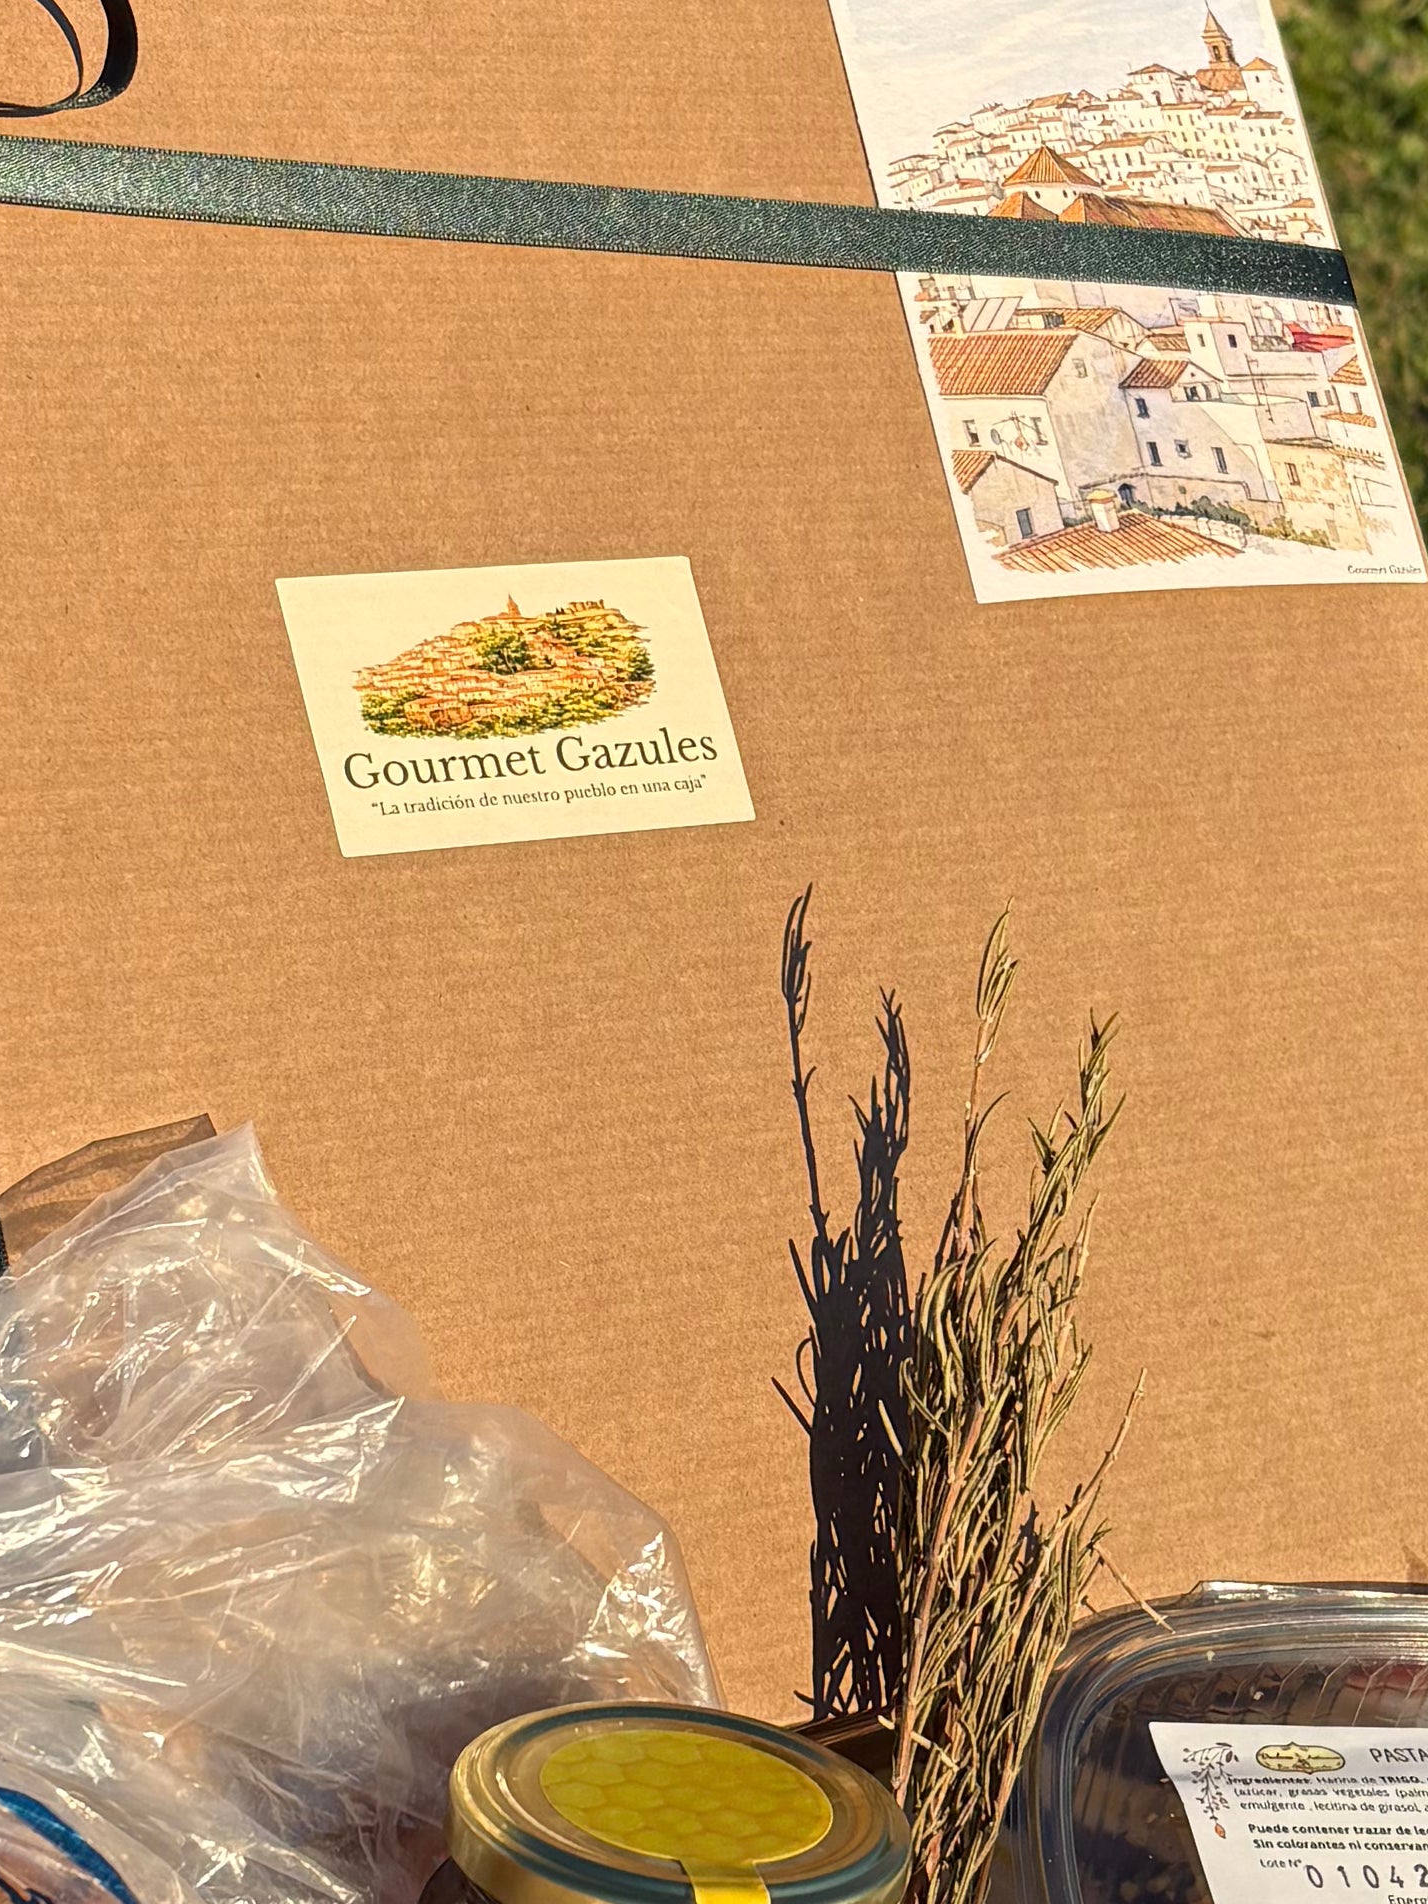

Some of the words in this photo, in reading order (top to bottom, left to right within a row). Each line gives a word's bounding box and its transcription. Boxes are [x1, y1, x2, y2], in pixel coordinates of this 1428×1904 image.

[344, 745, 546, 789] Gourmet
[555, 727, 718, 773] Gazules
[405, 793, 475, 815] tradición
[479, 792, 498, 807] de
[502, 791, 560, 806] nuestro
[565, 782, 617, 804] pueblo
[621, 784, 638, 796] en
[642, 781, 670, 793] una
[1248, 1824, 1289, 1835] Puede
[1292, 1825, 1350, 1835] contener
[1396, 1826, 1411, 1836] de
[1253, 1839, 1274, 1849] Sin
[1277, 1840, 1345, 1850] colorantes
